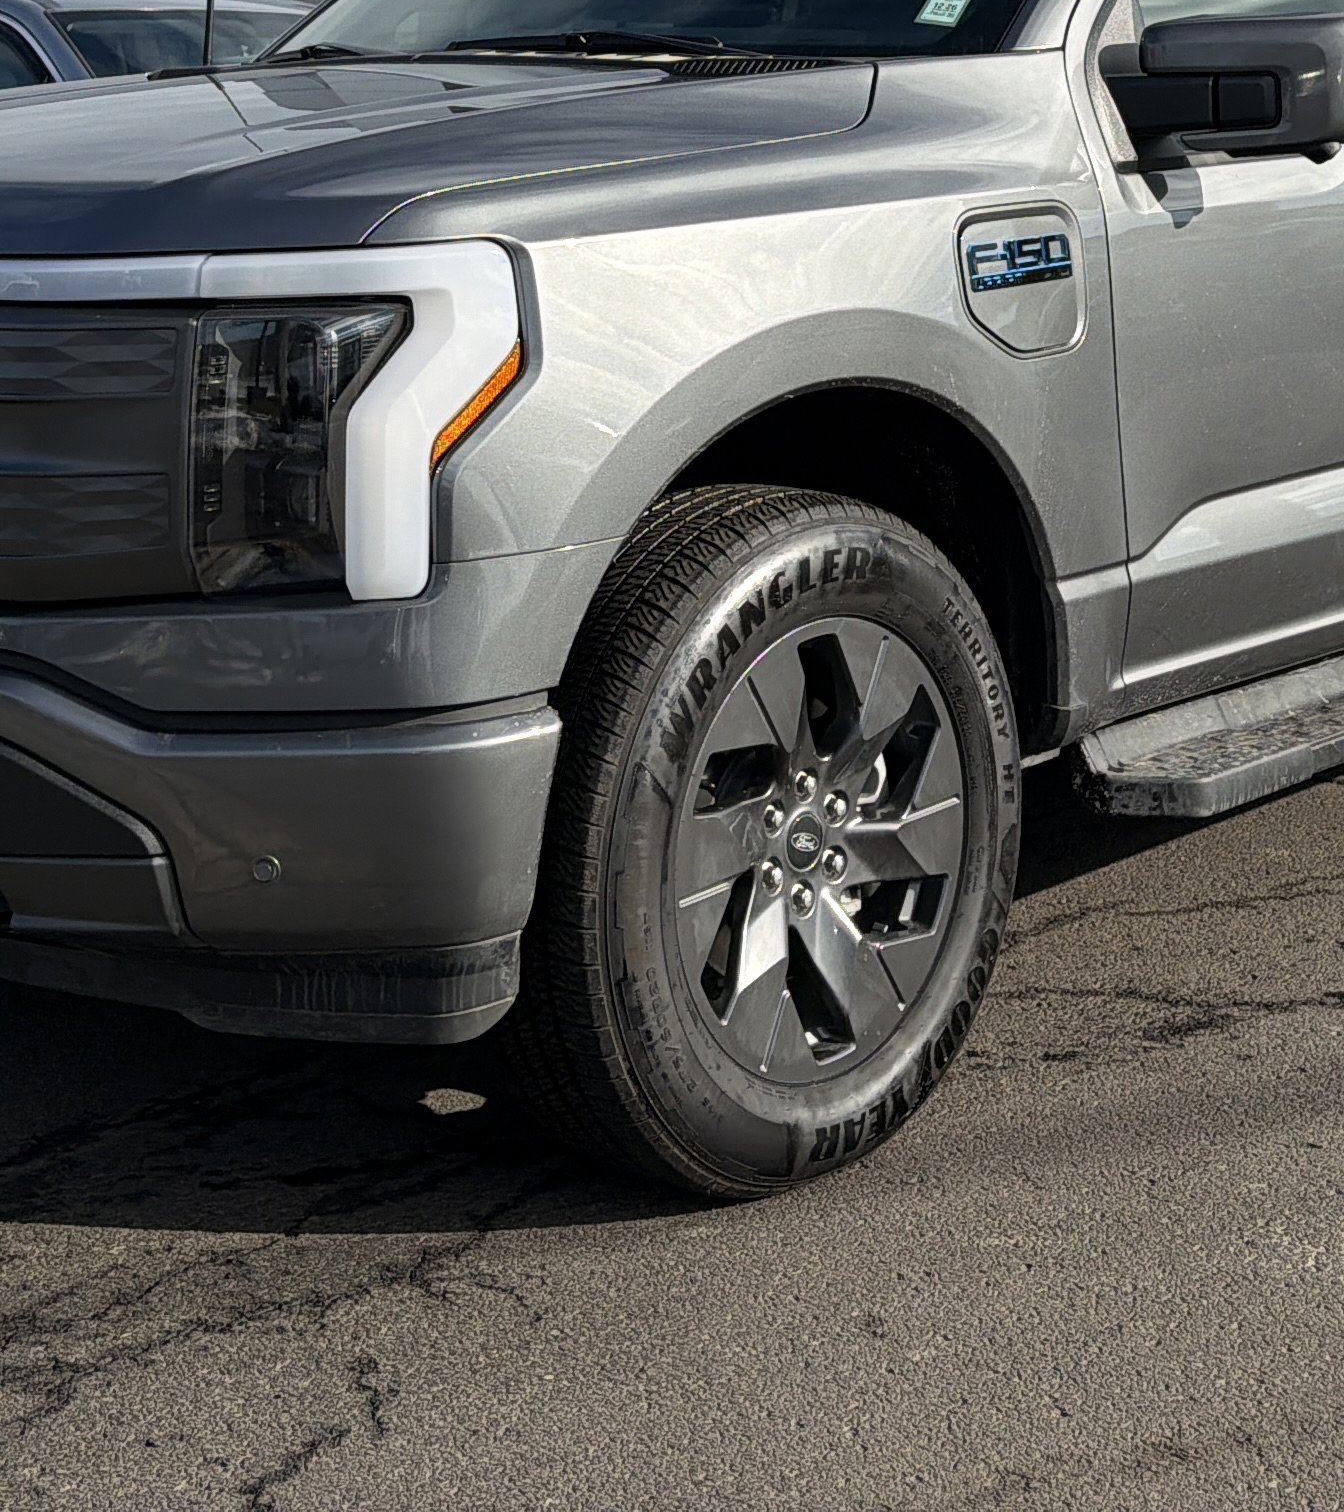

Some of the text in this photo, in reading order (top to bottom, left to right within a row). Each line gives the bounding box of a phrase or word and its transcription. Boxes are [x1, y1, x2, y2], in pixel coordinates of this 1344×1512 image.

[966, 232, 1071, 278] F-150
[660, 546, 872, 763] WRANGLER
[943, 596, 1010, 739] TERRITORY
